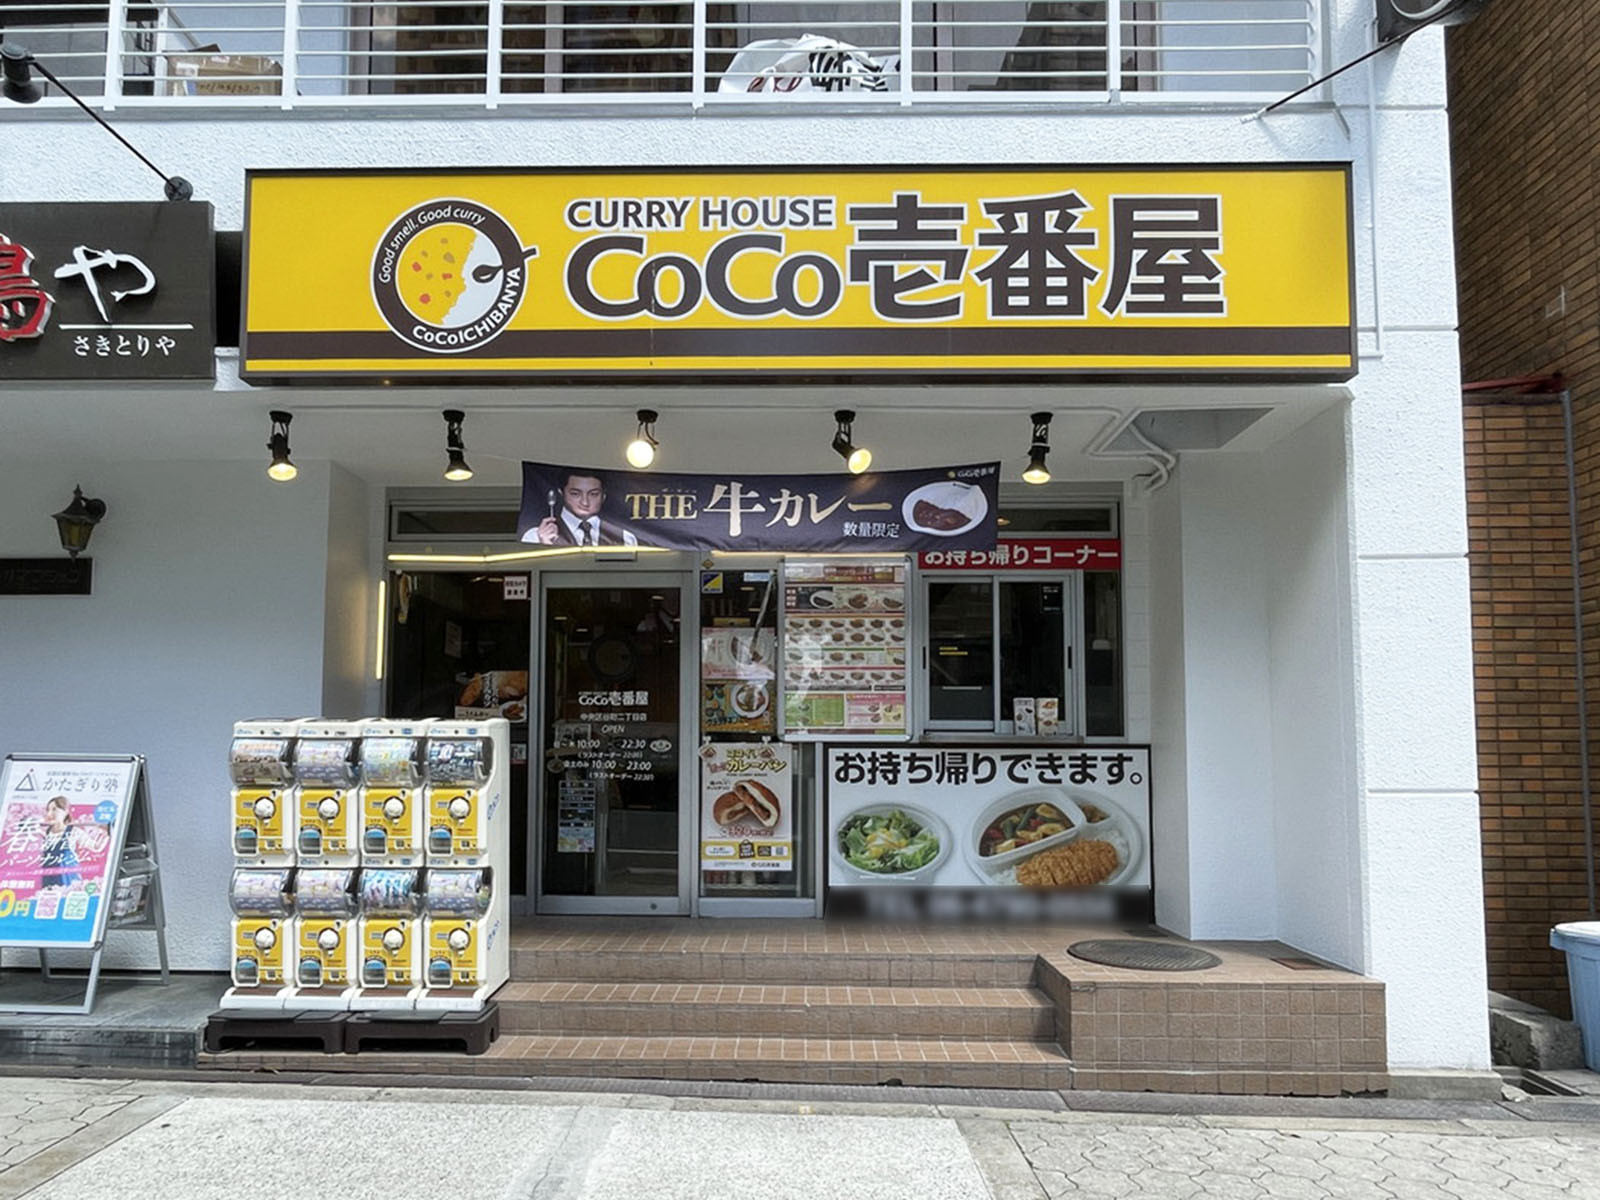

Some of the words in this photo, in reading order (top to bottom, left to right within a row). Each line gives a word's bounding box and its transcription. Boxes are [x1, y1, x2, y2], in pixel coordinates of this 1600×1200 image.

[566, 198, 692, 229] CURRY
[701, 197, 835, 228] HOUSE
[379, 247, 396, 284] Good
[390, 218, 420, 250] smell.
[417, 205, 452, 225] Good
[453, 207, 486, 226] curry
[565, 191, 1228, 321] CoCo壱番屋
[412, 266, 522, 345] CoCoICHIBANYA
[73, 334, 177, 357] さきとりや
[842, 522, 900, 539] 数量限定
[924, 544, 1119, 566] お持ち帰りコーナー
[601, 724, 626, 734] OPEN
[577, 739, 601, 750] 10:00
[591, 760, 617, 769] 10:00
[834, 751, 1143, 786] お持ち帰りできます。
